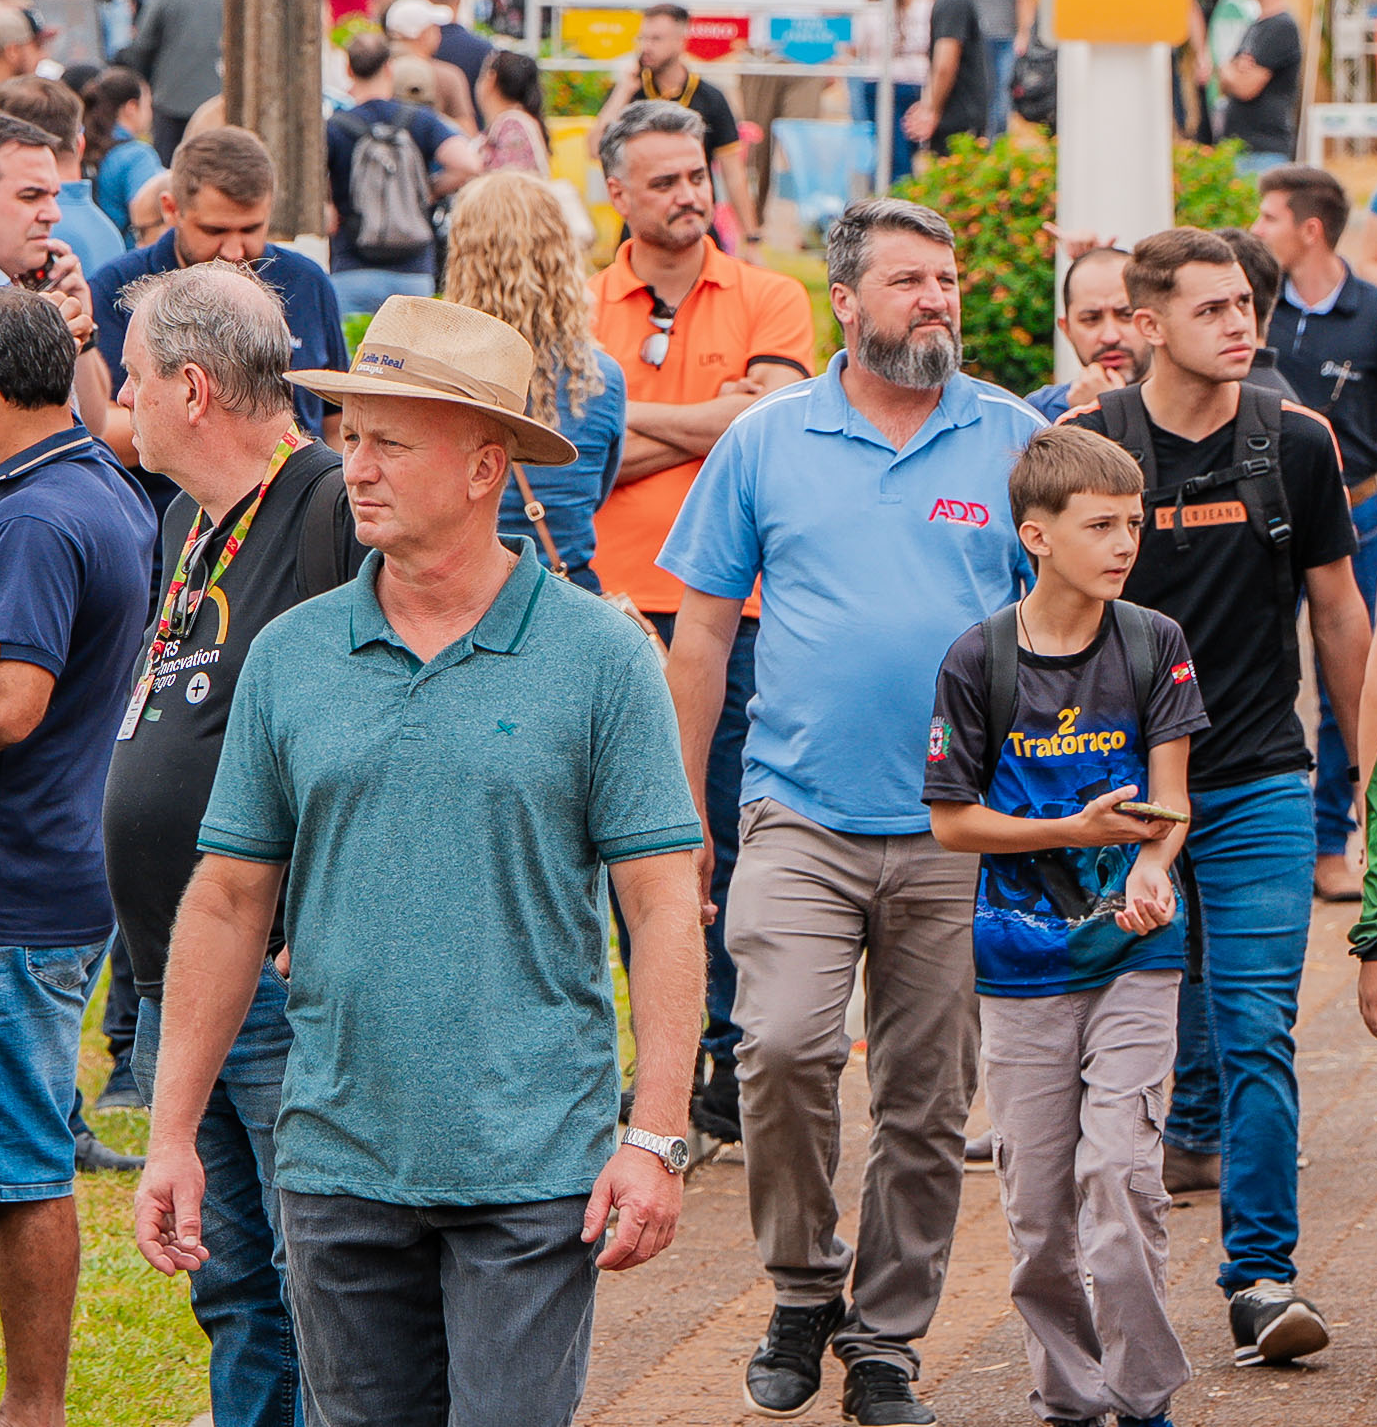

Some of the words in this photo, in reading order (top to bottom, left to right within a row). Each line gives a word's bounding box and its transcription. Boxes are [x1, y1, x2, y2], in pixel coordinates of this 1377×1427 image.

[380, 354, 405, 370] Real
[928, 497, 990, 528] ADD
[1202, 506, 1241, 521] JEANS
[162, 639, 181, 659] RS
[151, 673, 178, 694] agro
[1007, 730, 1127, 758] Tratoraço
